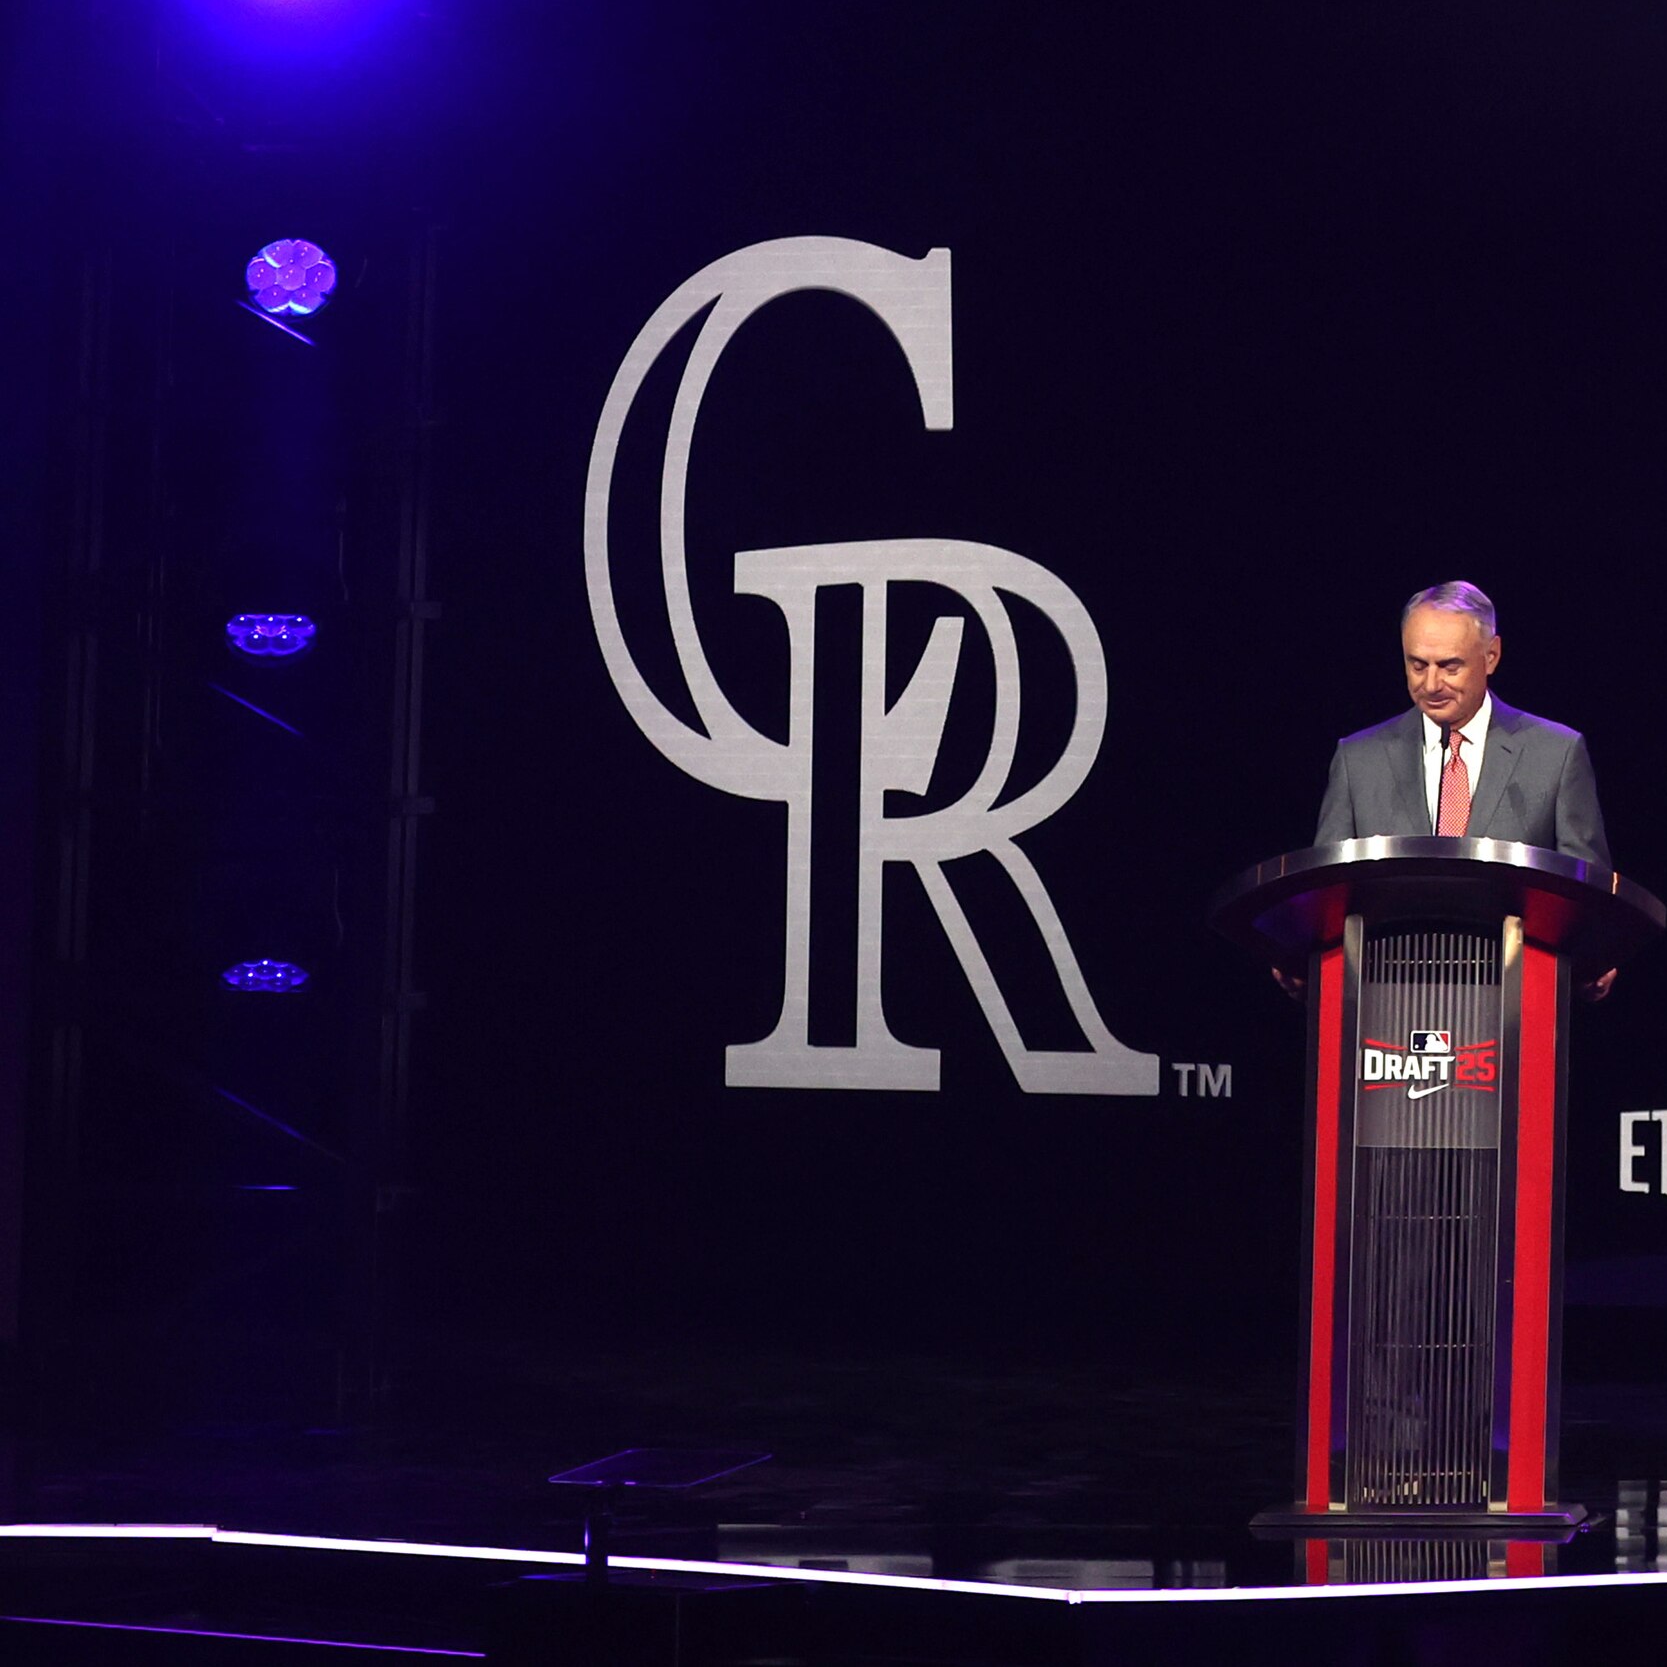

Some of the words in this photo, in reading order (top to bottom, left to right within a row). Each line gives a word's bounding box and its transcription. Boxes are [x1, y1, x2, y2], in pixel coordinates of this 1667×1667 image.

[1173, 1063, 1232, 1097] TM
[1363, 1048, 1456, 1081] DRAFT
[1456, 1050, 1497, 1082] 25
